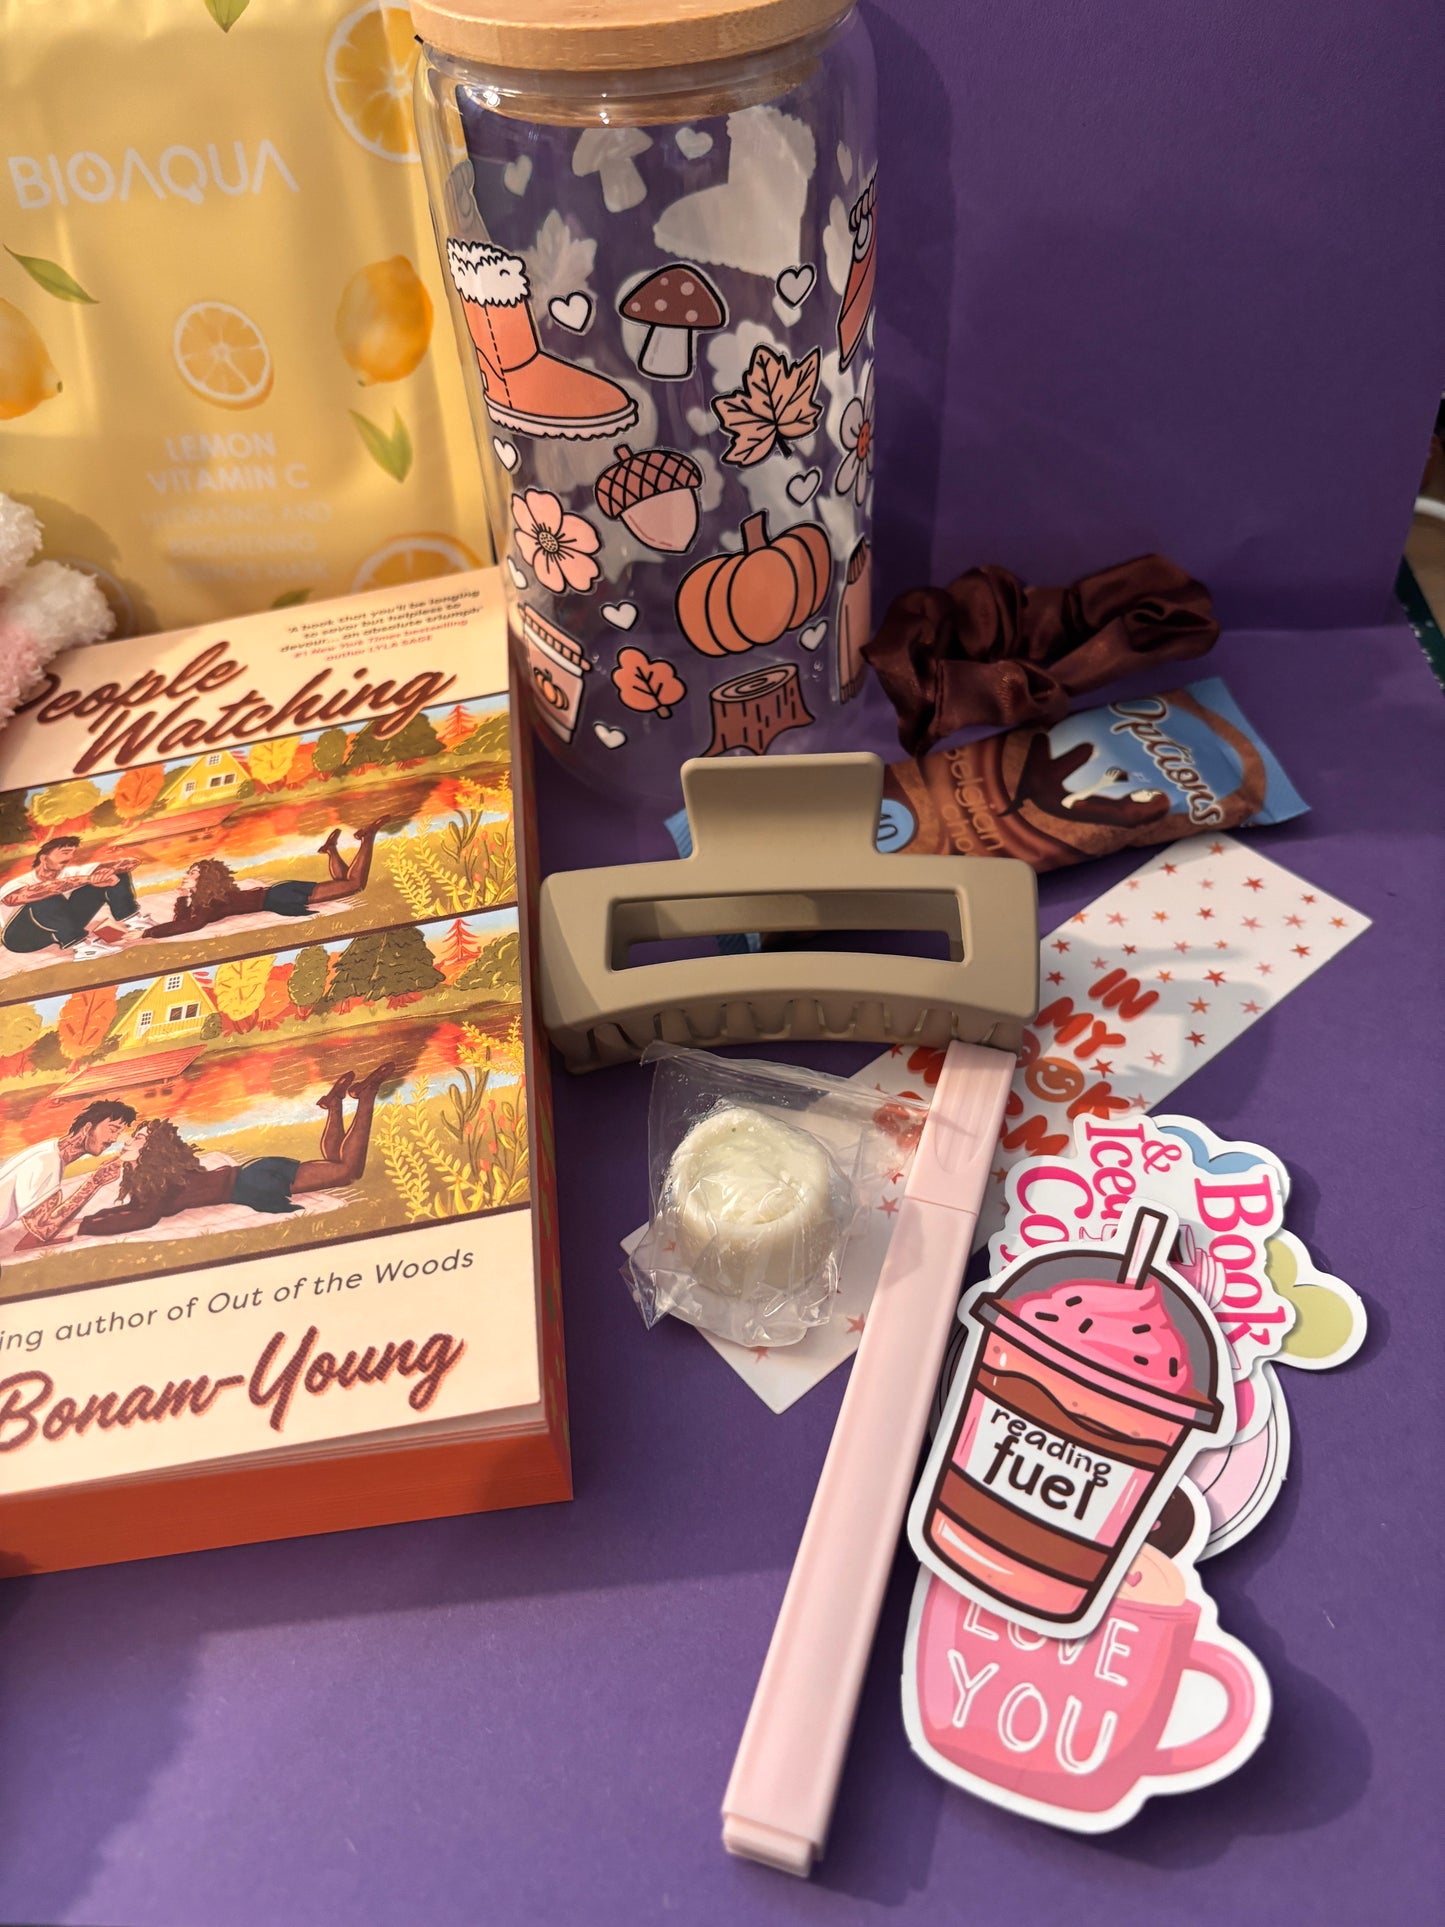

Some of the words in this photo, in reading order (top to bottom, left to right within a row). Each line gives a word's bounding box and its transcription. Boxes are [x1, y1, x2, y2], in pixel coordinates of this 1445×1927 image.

[8, 138, 300, 210] BIOAQUA
[165, 431, 277, 462] LEMON
[146, 464, 277, 496] VITAMIN
[284, 461, 310, 490] C
[302, 619, 334, 631] book
[339, 612, 367, 623] that
[370, 603, 407, 618] you'll
[409, 601, 427, 610] be
[429, 590, 480, 604] longing
[304, 632, 319, 640] to
[362, 617, 384, 628] but
[388, 606, 444, 621] helpless
[446, 602, 462, 611] to
[311, 645, 336, 655] New
[340, 639, 364, 649] York
[368, 632, 401, 643] Times
[404, 618, 469, 637] bestselling
[343, 631, 360, 640] an
[363, 619, 423, 636] absolute
[326, 648, 366, 661] author
[369, 641, 399, 653] LYLA
[401, 633, 433, 647] SAGE
[72, 667, 459, 776] Watching
[1108, 697, 1225, 825] Options
[941, 803, 976, 855] cho
[1088, 967, 1160, 1021] IN
[1033, 996, 1127, 1059] MY
[1141, 1139, 1182, 1175] &
[1194, 1174, 1287, 1346] Book
[55, 1306, 158, 1341] author
[167, 1297, 198, 1321] of
[207, 1287, 263, 1314] Out
[273, 1277, 307, 1302] of
[313, 1272, 363, 1297] the
[375, 1248, 475, 1284] Woods
[0, 1325, 468, 1454] Bonam-Young
[990, 1407, 1112, 1488] reading
[982, 1434, 1096, 1521] fuel
[947, 1648, 1118, 1775] YOU
